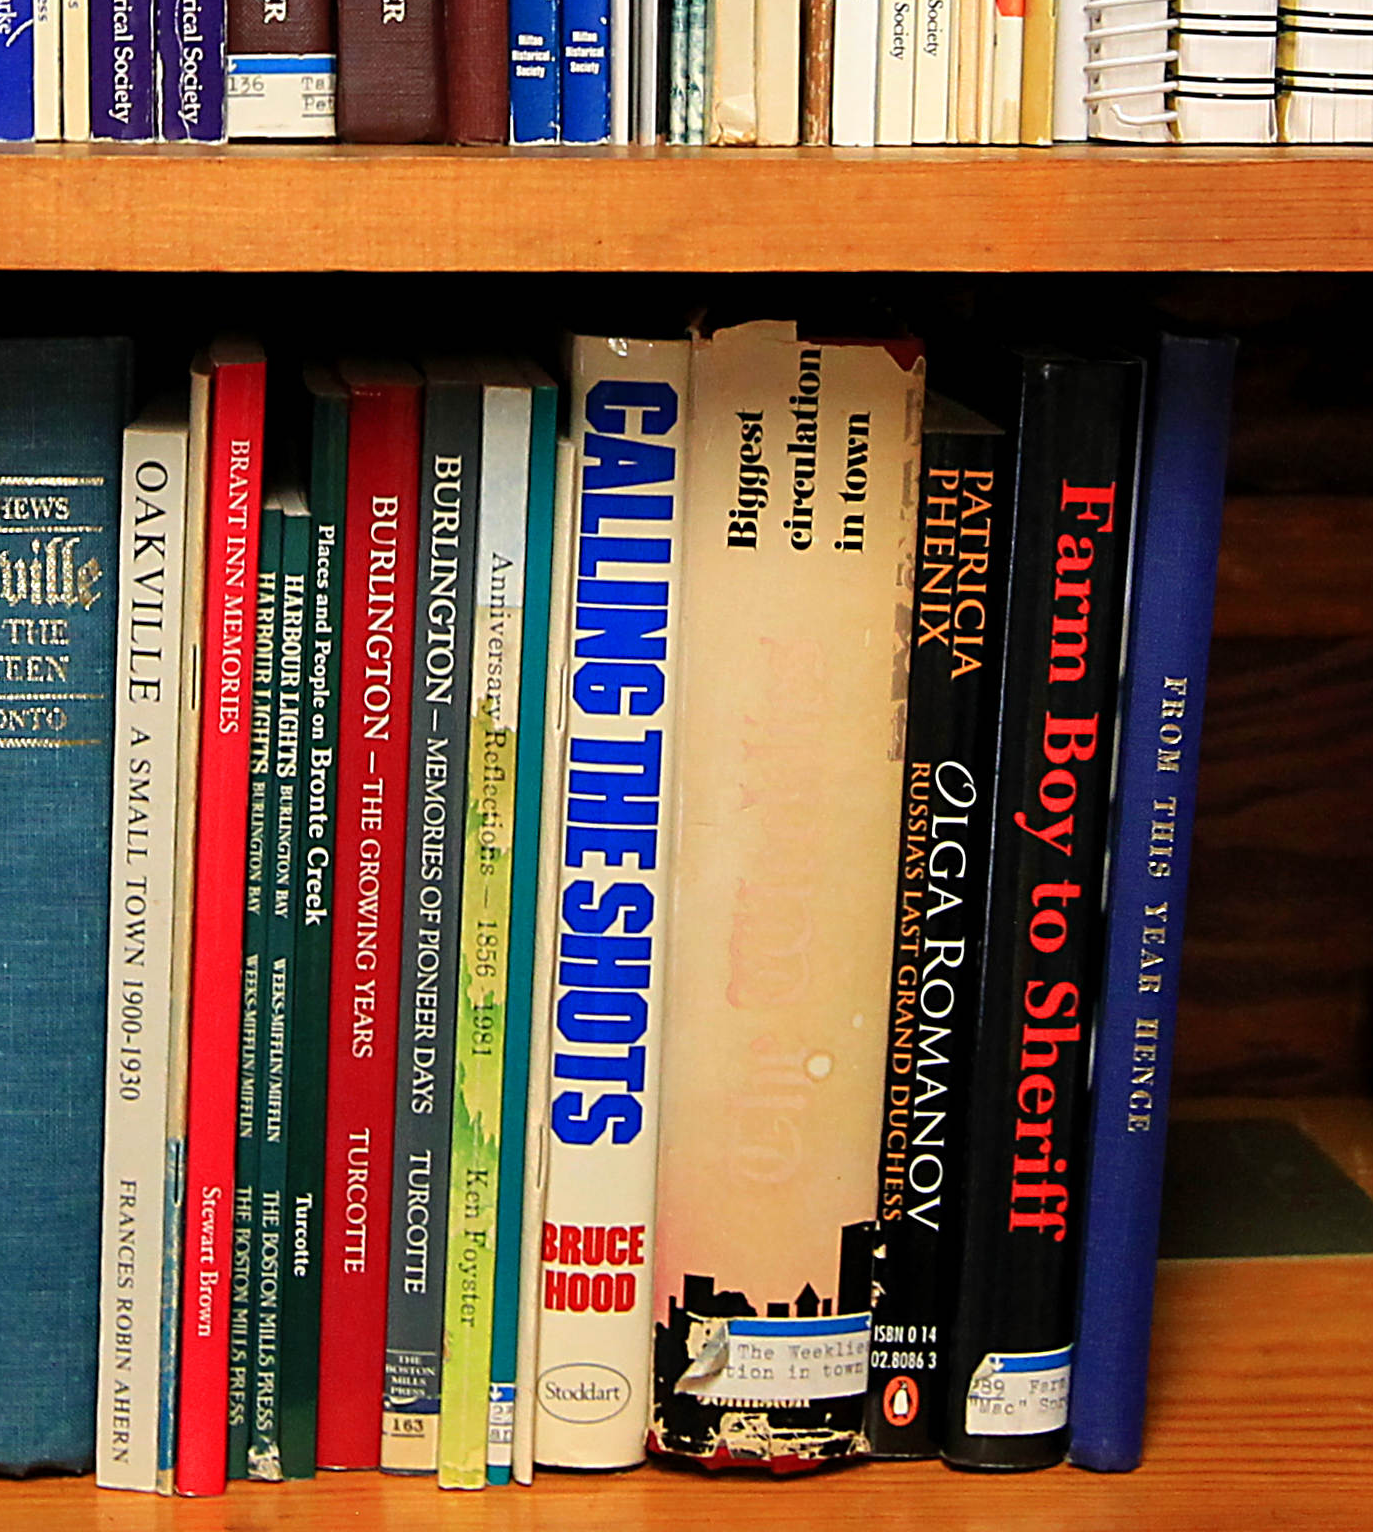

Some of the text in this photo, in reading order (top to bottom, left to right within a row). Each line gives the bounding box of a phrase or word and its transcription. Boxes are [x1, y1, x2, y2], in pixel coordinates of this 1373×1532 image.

[728, 409, 770, 553] Biggest
[783, 349, 821, 552] circulation
[834, 411, 870, 554] in town
[2, 619, 70, 644] THE
[219, 440, 250, 734] BRANT INN MEMORIES
[918, 467, 959, 647] PHENIX
[951, 469, 994, 680] PATRICIA
[119, 461, 169, 1102] OAKVILLE A SMALL TOWN 1900-1930
[351, 495, 398, 1058] BURLINGTON THE GROWING YEARS
[552, 380, 678, 1145] CALLING THE SHOTS
[1009, 478, 1115, 1242] Farm Boy to Sheriff
[907, 761, 977, 1232] OLGA ROMANOV
[1128, 677, 1187, 1132] FROM THIS YEAR HENCE
[541, 1221, 644, 1265] BRUCE
[545, 1270, 636, 1313] HOOD
[546, 1382, 620, 1401] Stoddart
